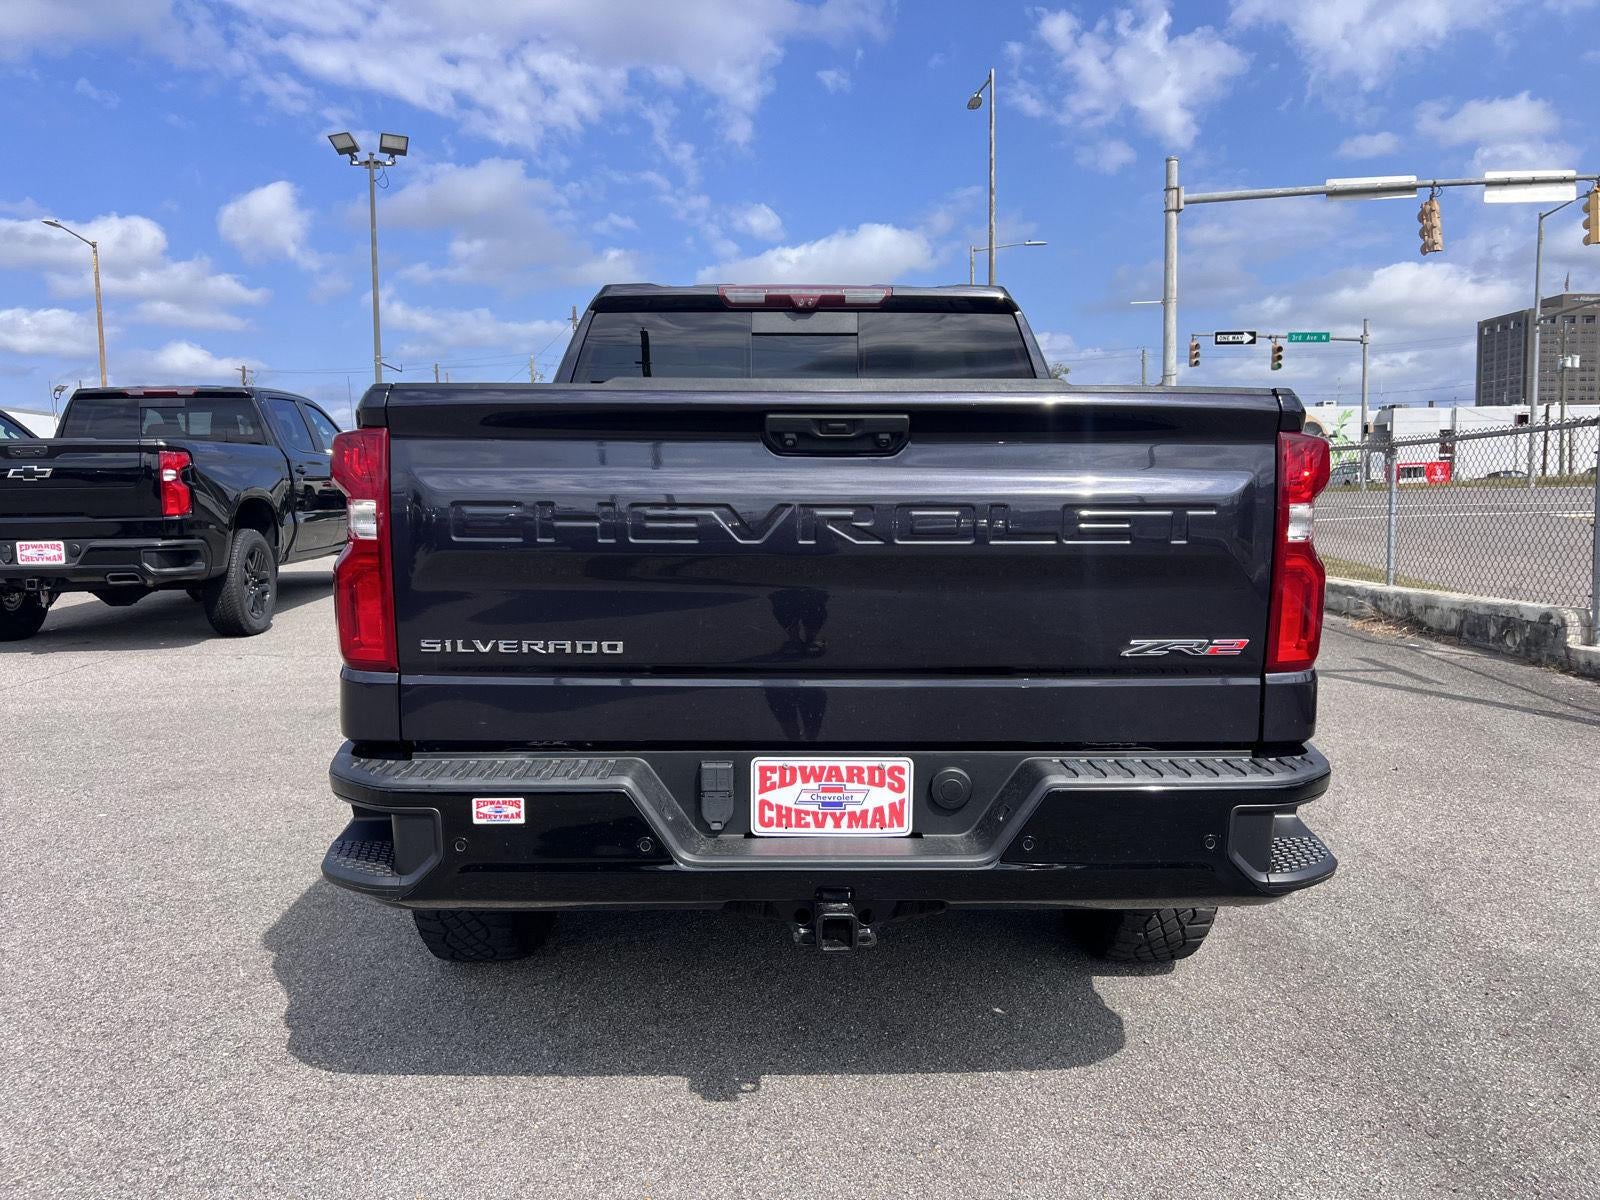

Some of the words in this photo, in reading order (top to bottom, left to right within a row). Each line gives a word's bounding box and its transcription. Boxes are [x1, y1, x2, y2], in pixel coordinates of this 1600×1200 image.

[1291, 333, 1302, 341] 3rd
[1306, 333, 1317, 341] Ave
[1321, 333, 1327, 341] N
[449, 501, 1217, 544] CHEVROLET
[19, 543, 62, 552] EDWARDS
[20, 553, 63, 562] CHEVYMAN
[420, 638, 624, 655] SILVERADO
[1120, 639, 1250, 657] ZR2
[758, 765, 906, 795] EDWARDS
[810, 793, 854, 801] Chevrolet
[475, 800, 521, 809] EDWARDS
[475, 811, 522, 819] CHEVYMAN
[758, 798, 906, 829] CHEVYMAN
